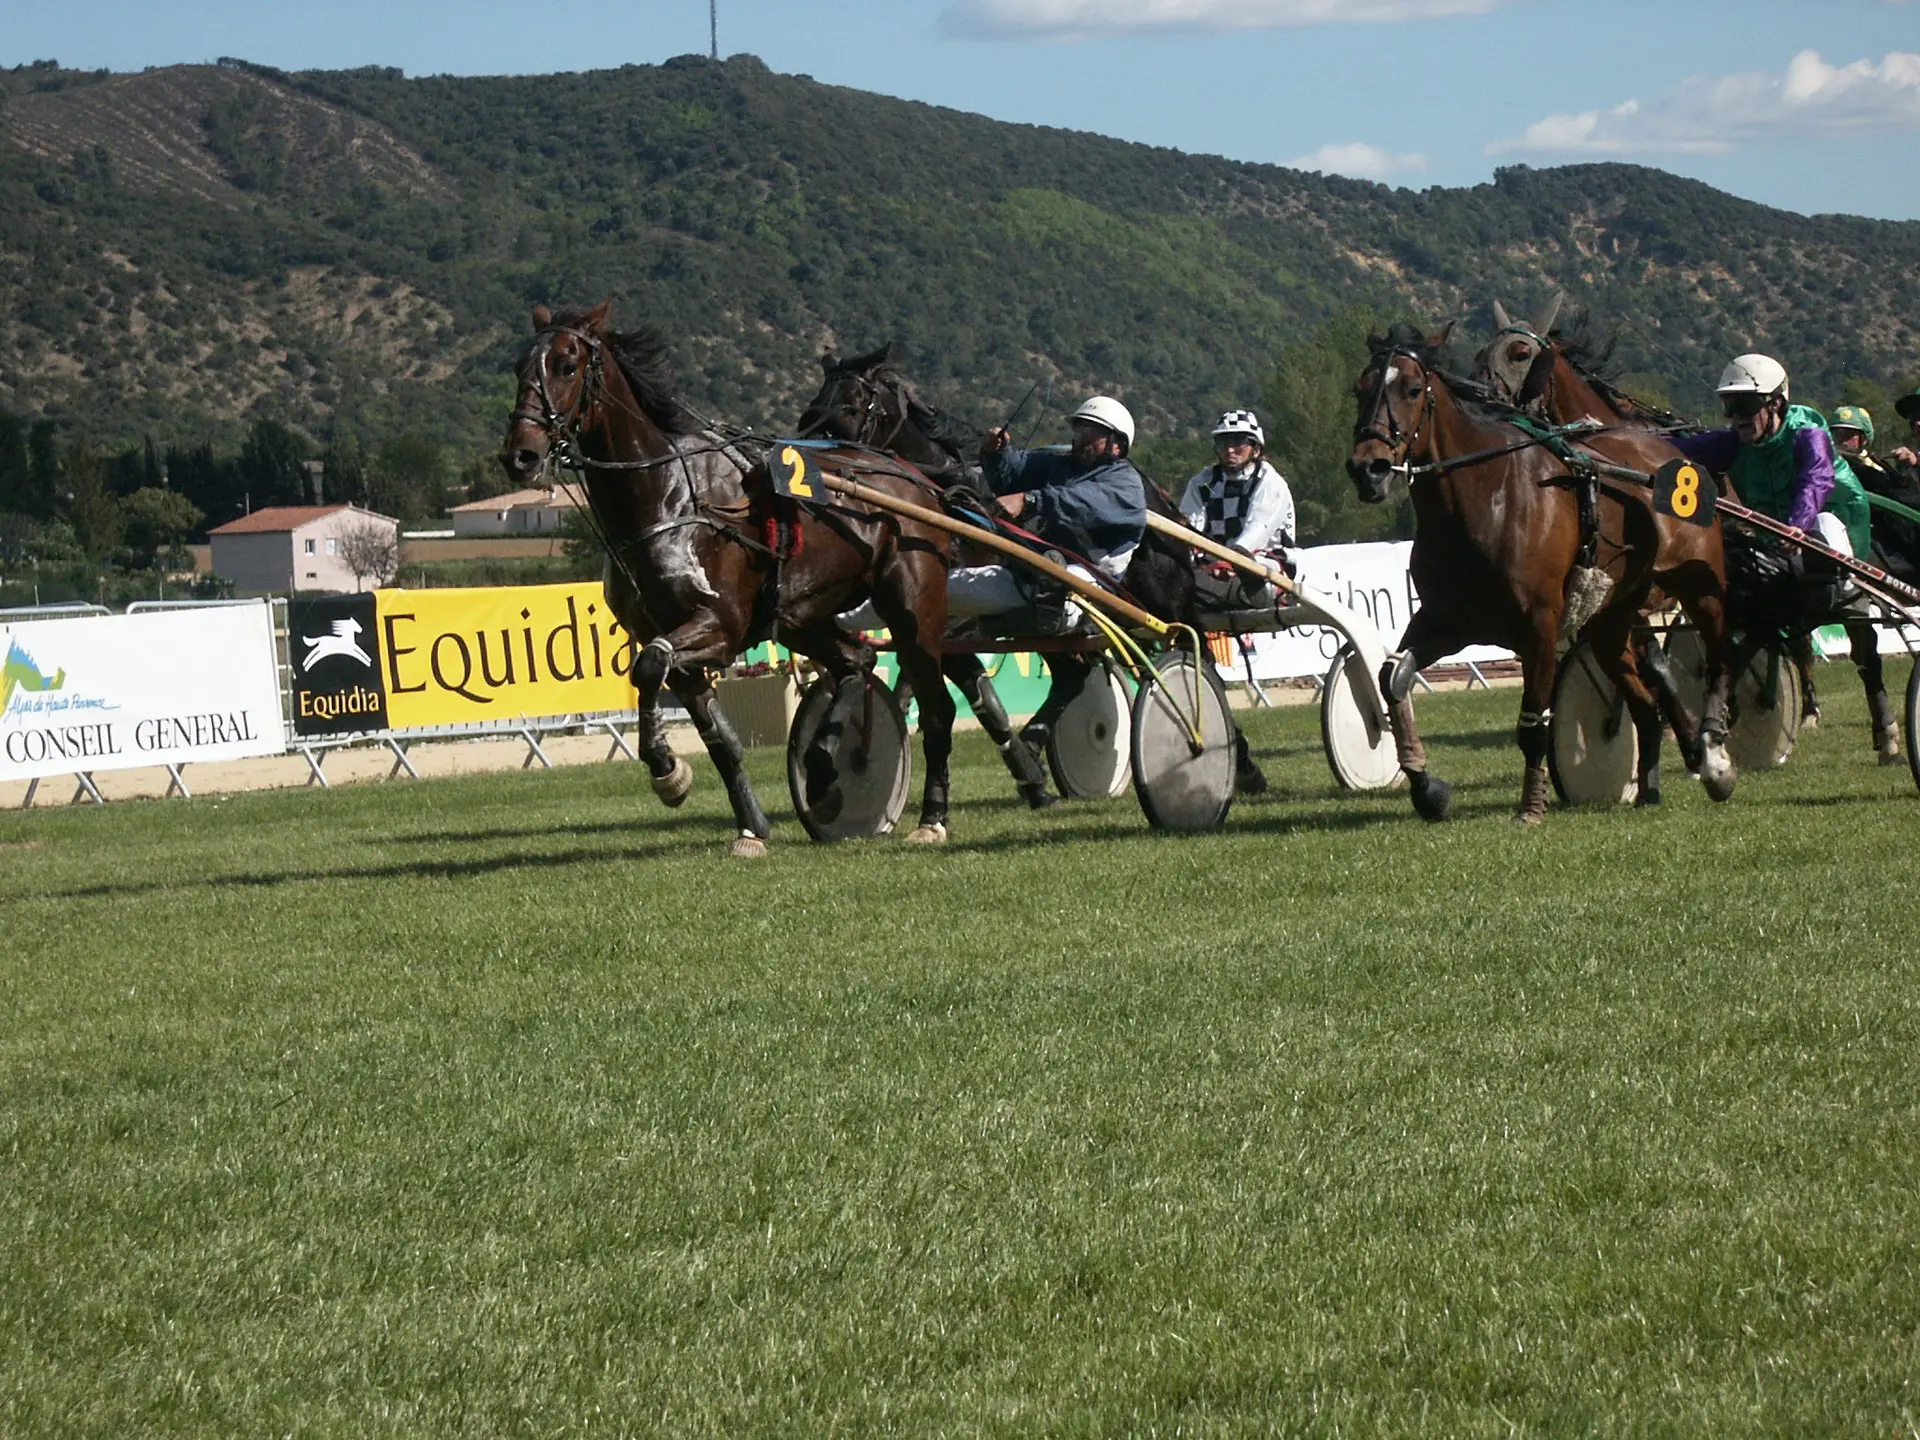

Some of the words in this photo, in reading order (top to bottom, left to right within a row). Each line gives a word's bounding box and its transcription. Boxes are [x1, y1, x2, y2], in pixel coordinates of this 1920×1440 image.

[782, 447, 813, 497] 2
[1671, 465, 1699, 518] 8
[5, 723, 122, 764] CONSEIL
[135, 710, 258, 752] GENERAL
